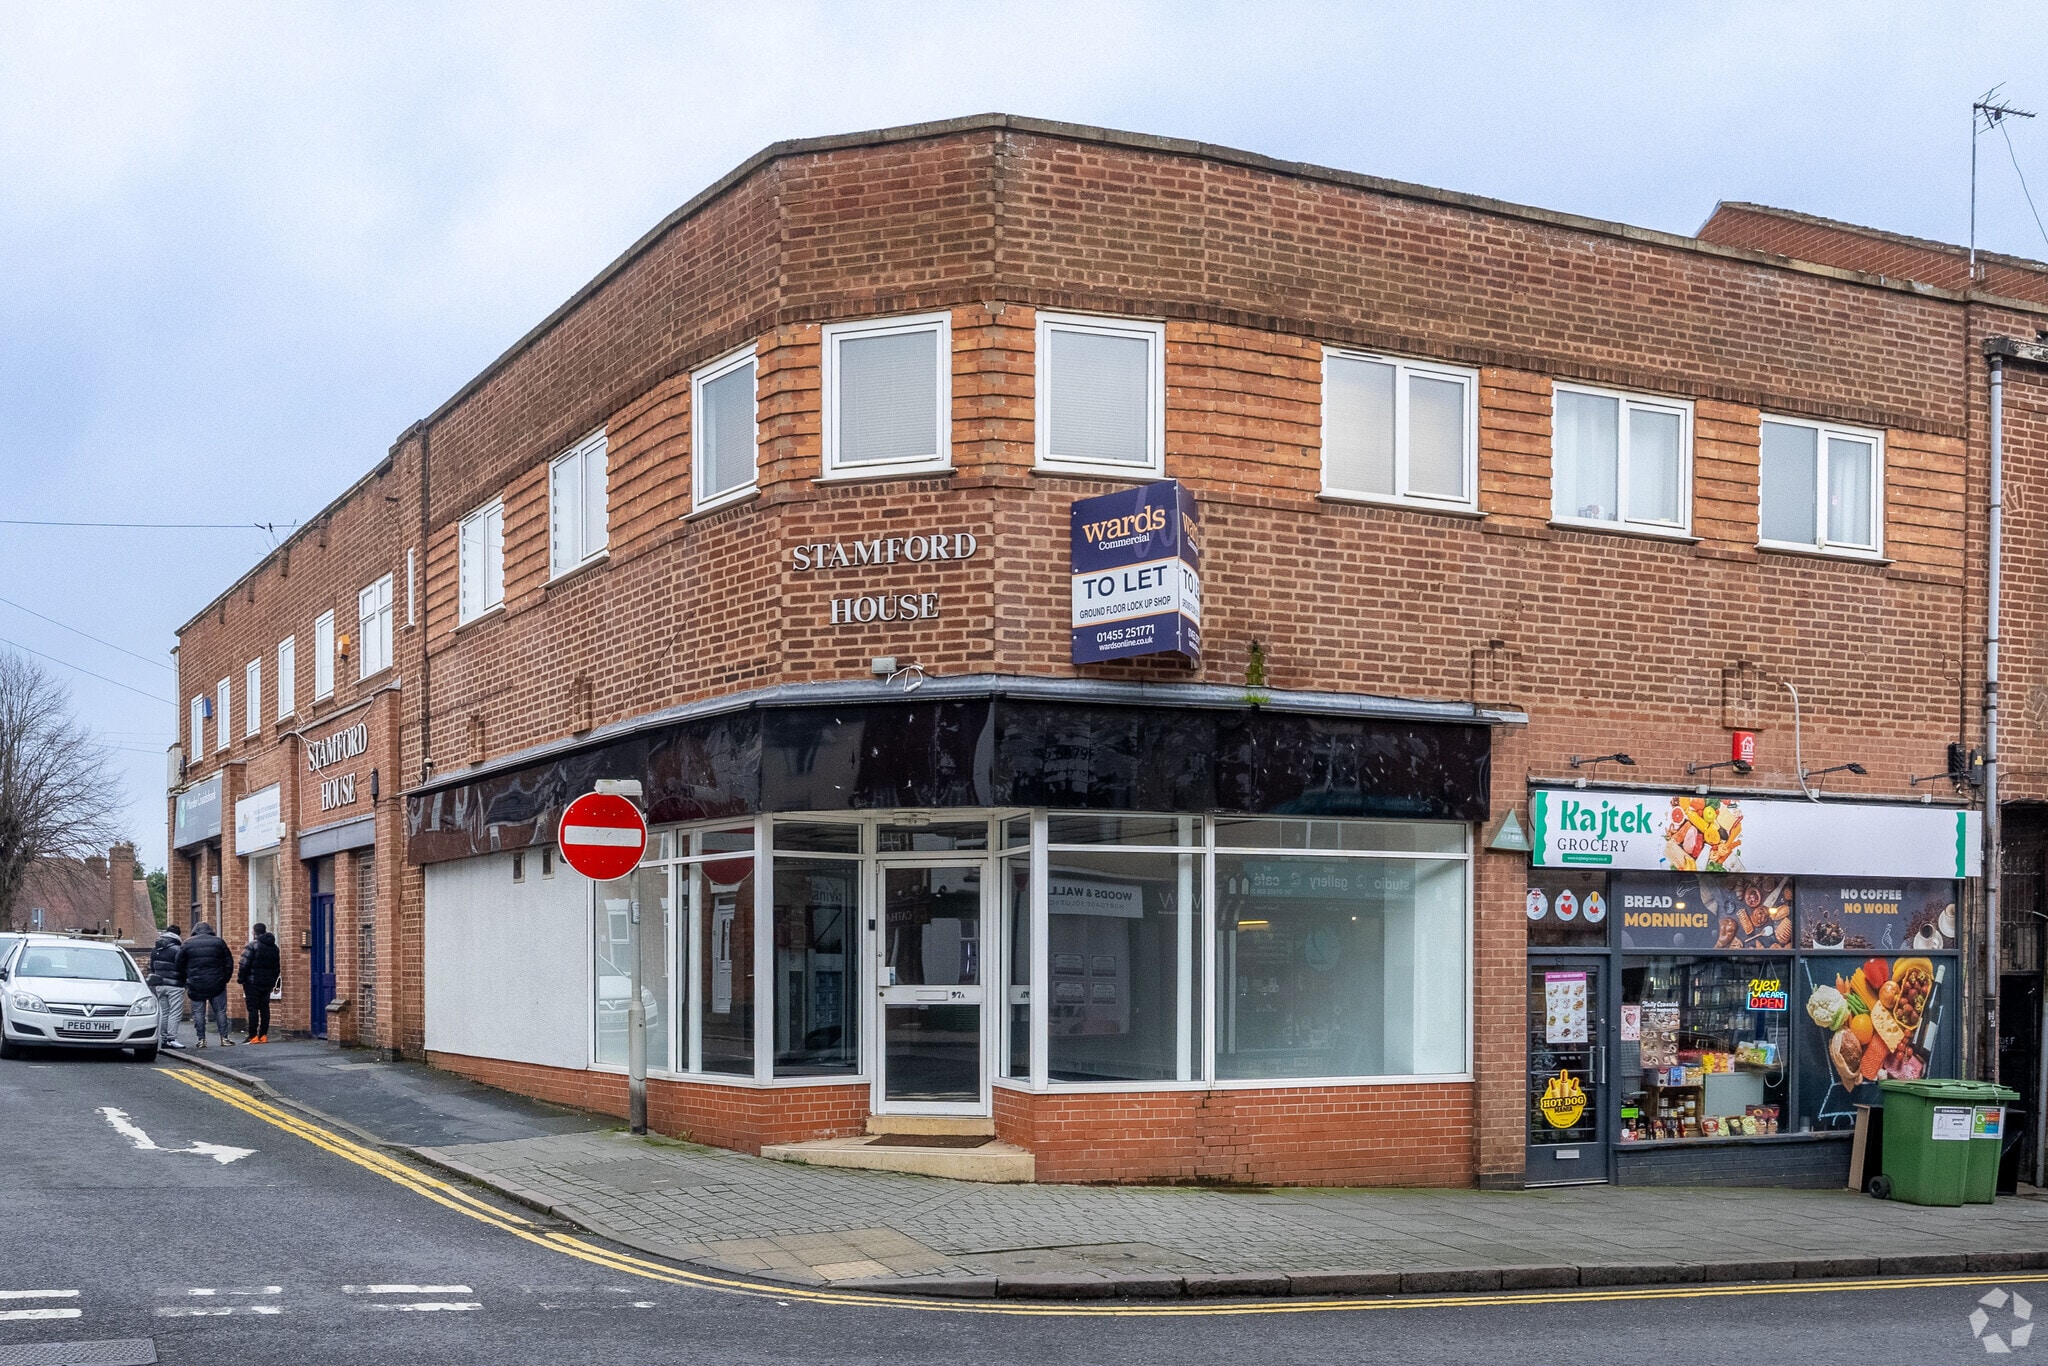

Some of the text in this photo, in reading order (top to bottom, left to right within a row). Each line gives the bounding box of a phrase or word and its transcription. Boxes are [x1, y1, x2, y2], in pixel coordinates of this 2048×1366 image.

[1082, 505, 1166, 543] wards
[1098, 533, 1150, 551] Commercial
[793, 533, 977, 570] STAMFORD
[1083, 565, 1168, 600] TO LET
[1183, 569, 1194, 594] TO
[829, 593, 940, 625] HOUSE
[1079, 595, 1171, 619] GROUND FLOOR LOCK UP SHOP
[1096, 624, 1155, 643] 01455 251771
[1098, 636, 1154, 651] wardsonline.co.uk
[308, 723, 368, 771] STAMFORD
[321, 773, 357, 811] HOUSE
[1560, 800, 1653, 840] Kajtek
[1557, 838, 1630, 852] GROCERY
[1624, 895, 1673, 908] BREAD
[1841, 889, 1902, 900] NO COFFEE
[1844, 903, 1898, 914] NO WORK
[1624, 912, 1708, 928] MORNING!
[1750, 998, 1784, 1008] OPEN
[67, 1022, 110, 1030] PE60 YHH
[1543, 1096, 1584, 1108] HOT DOG
